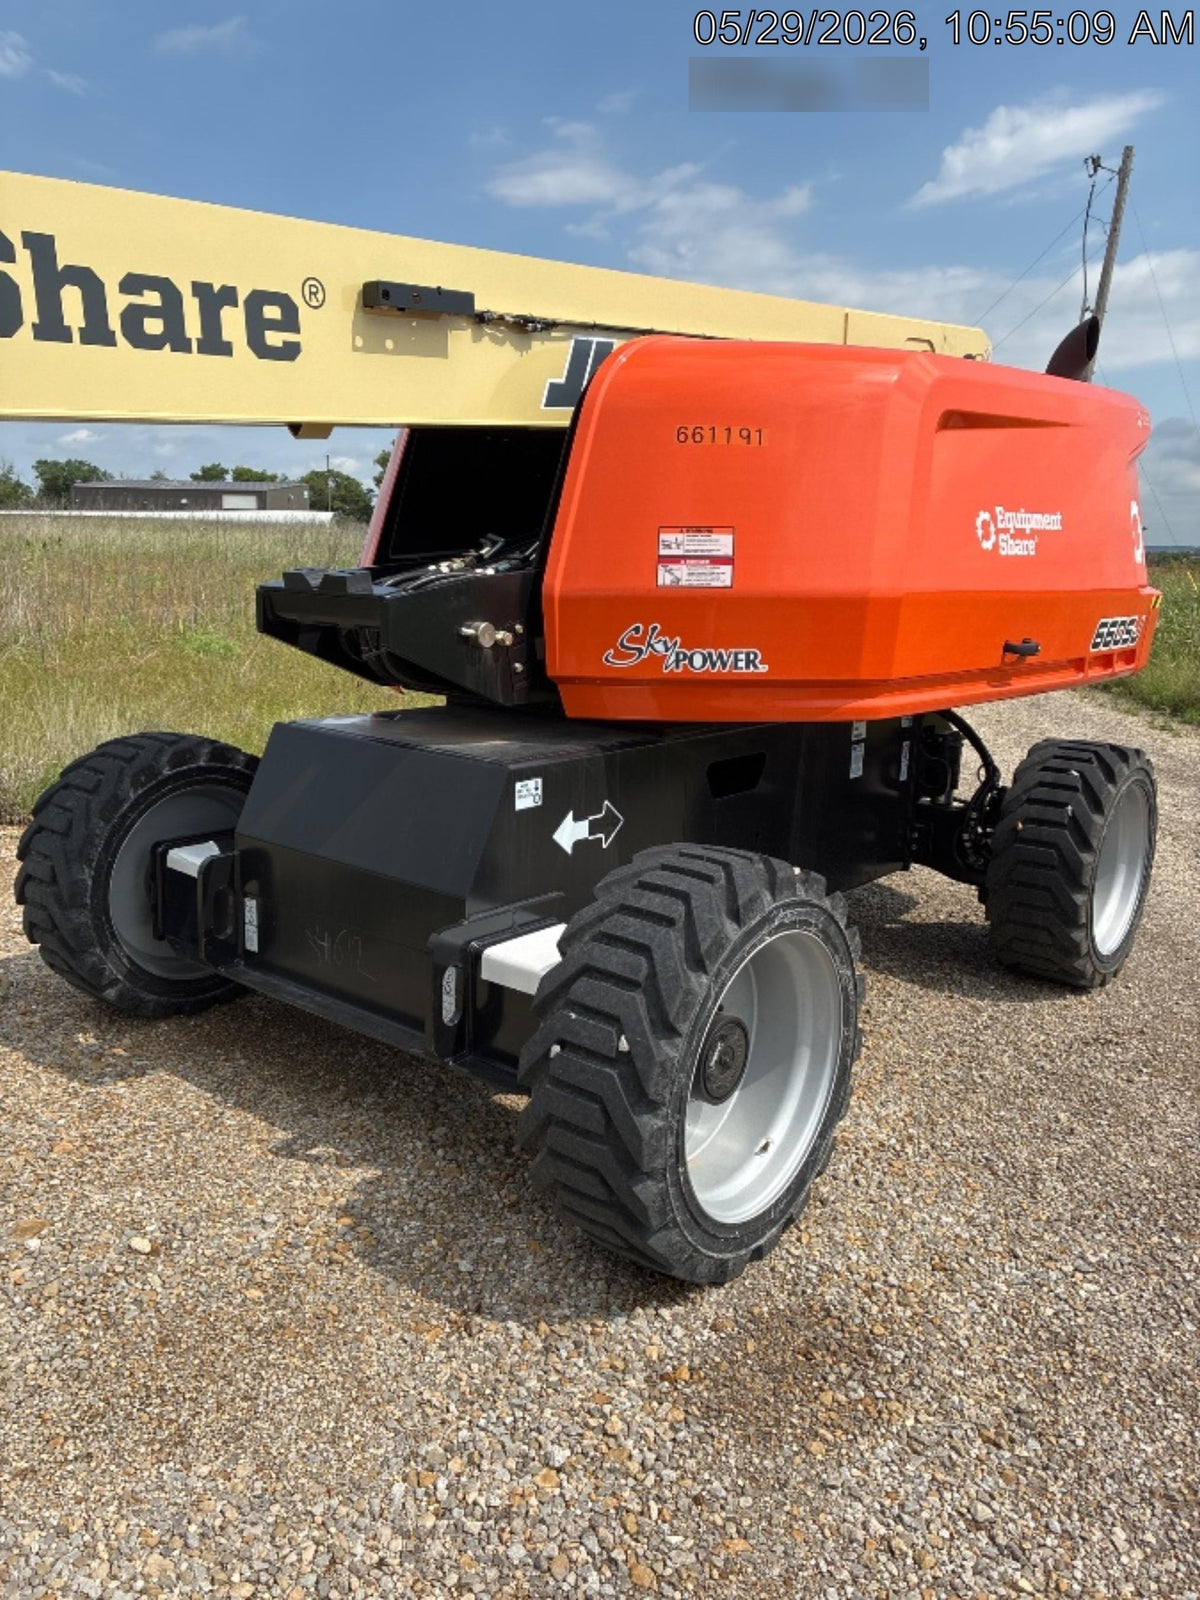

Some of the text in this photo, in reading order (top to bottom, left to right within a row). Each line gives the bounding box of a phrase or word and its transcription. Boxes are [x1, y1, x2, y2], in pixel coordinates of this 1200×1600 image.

[676, 425, 762, 446] 661191
[995, 505, 1063, 534] Equipment
[998, 532, 1037, 556] Share
